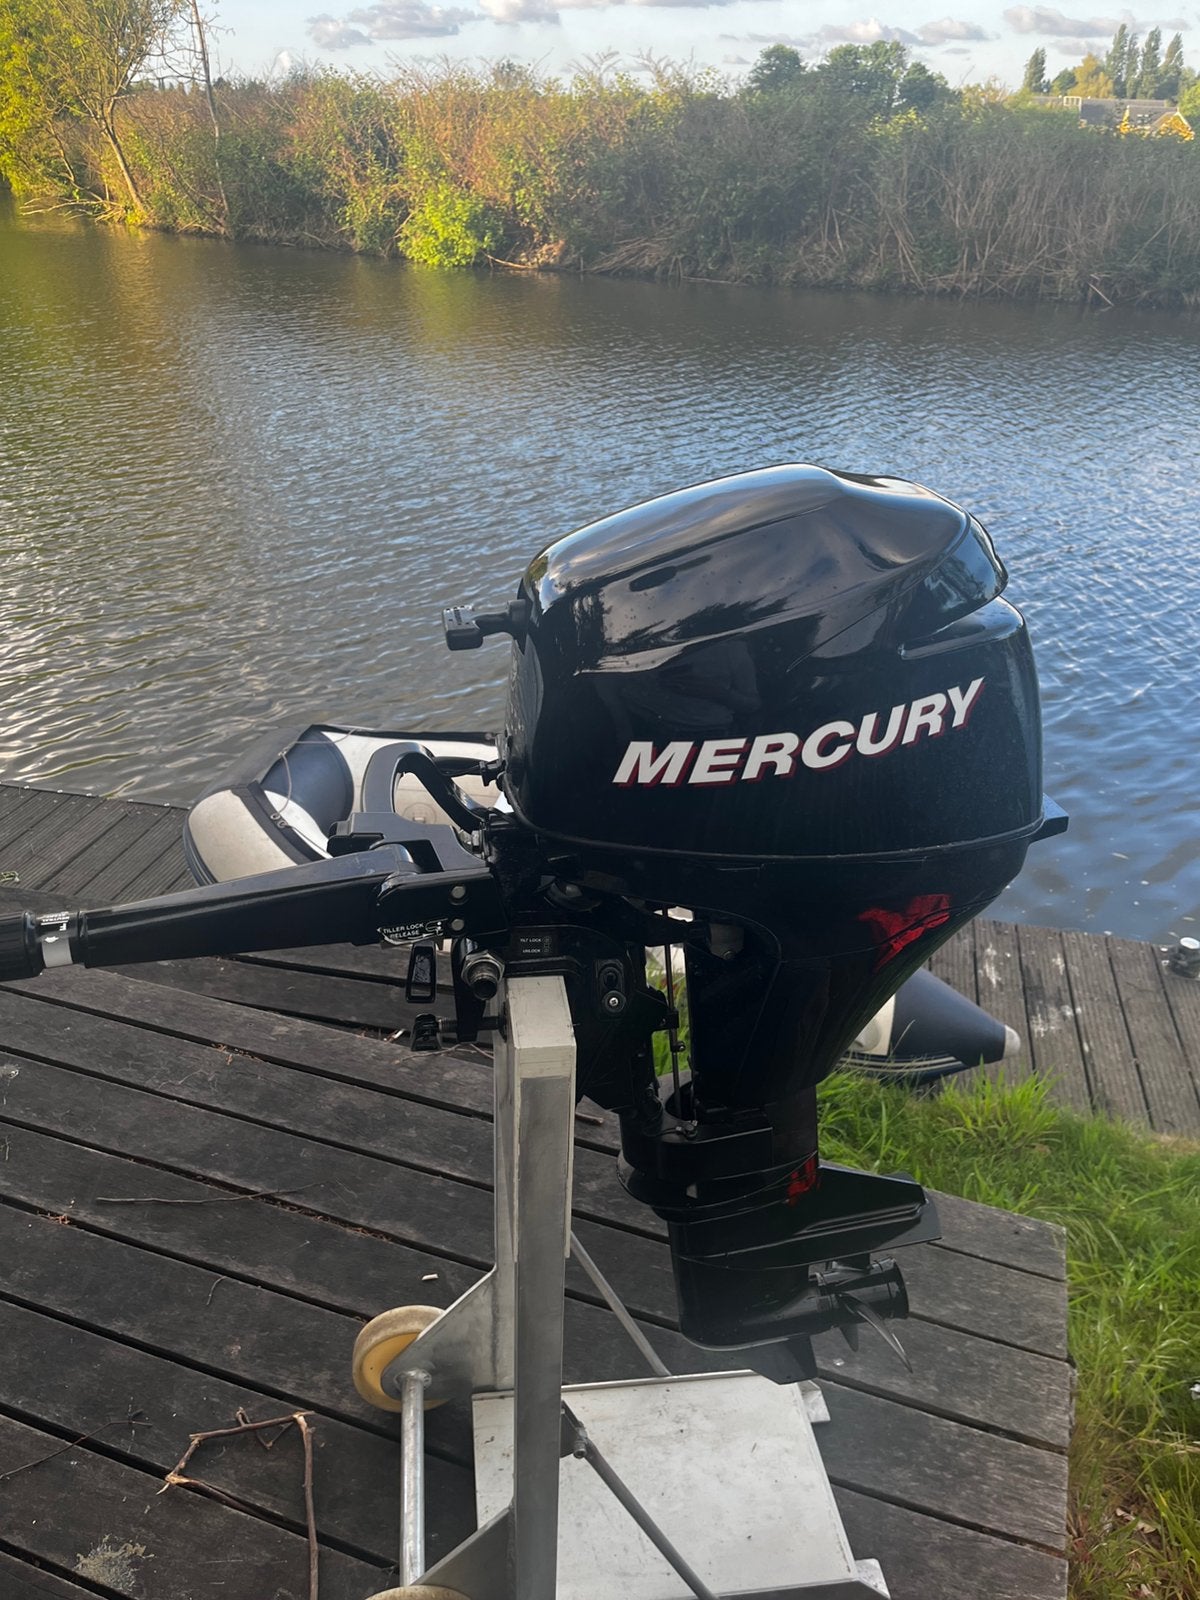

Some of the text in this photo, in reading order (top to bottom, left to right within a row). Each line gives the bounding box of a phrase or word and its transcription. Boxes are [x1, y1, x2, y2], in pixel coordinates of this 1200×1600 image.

[612, 677, 985, 788] MERCURY
[383, 923, 424, 934] TILLER LOCK
[389, 930, 420, 939] RELEASE
